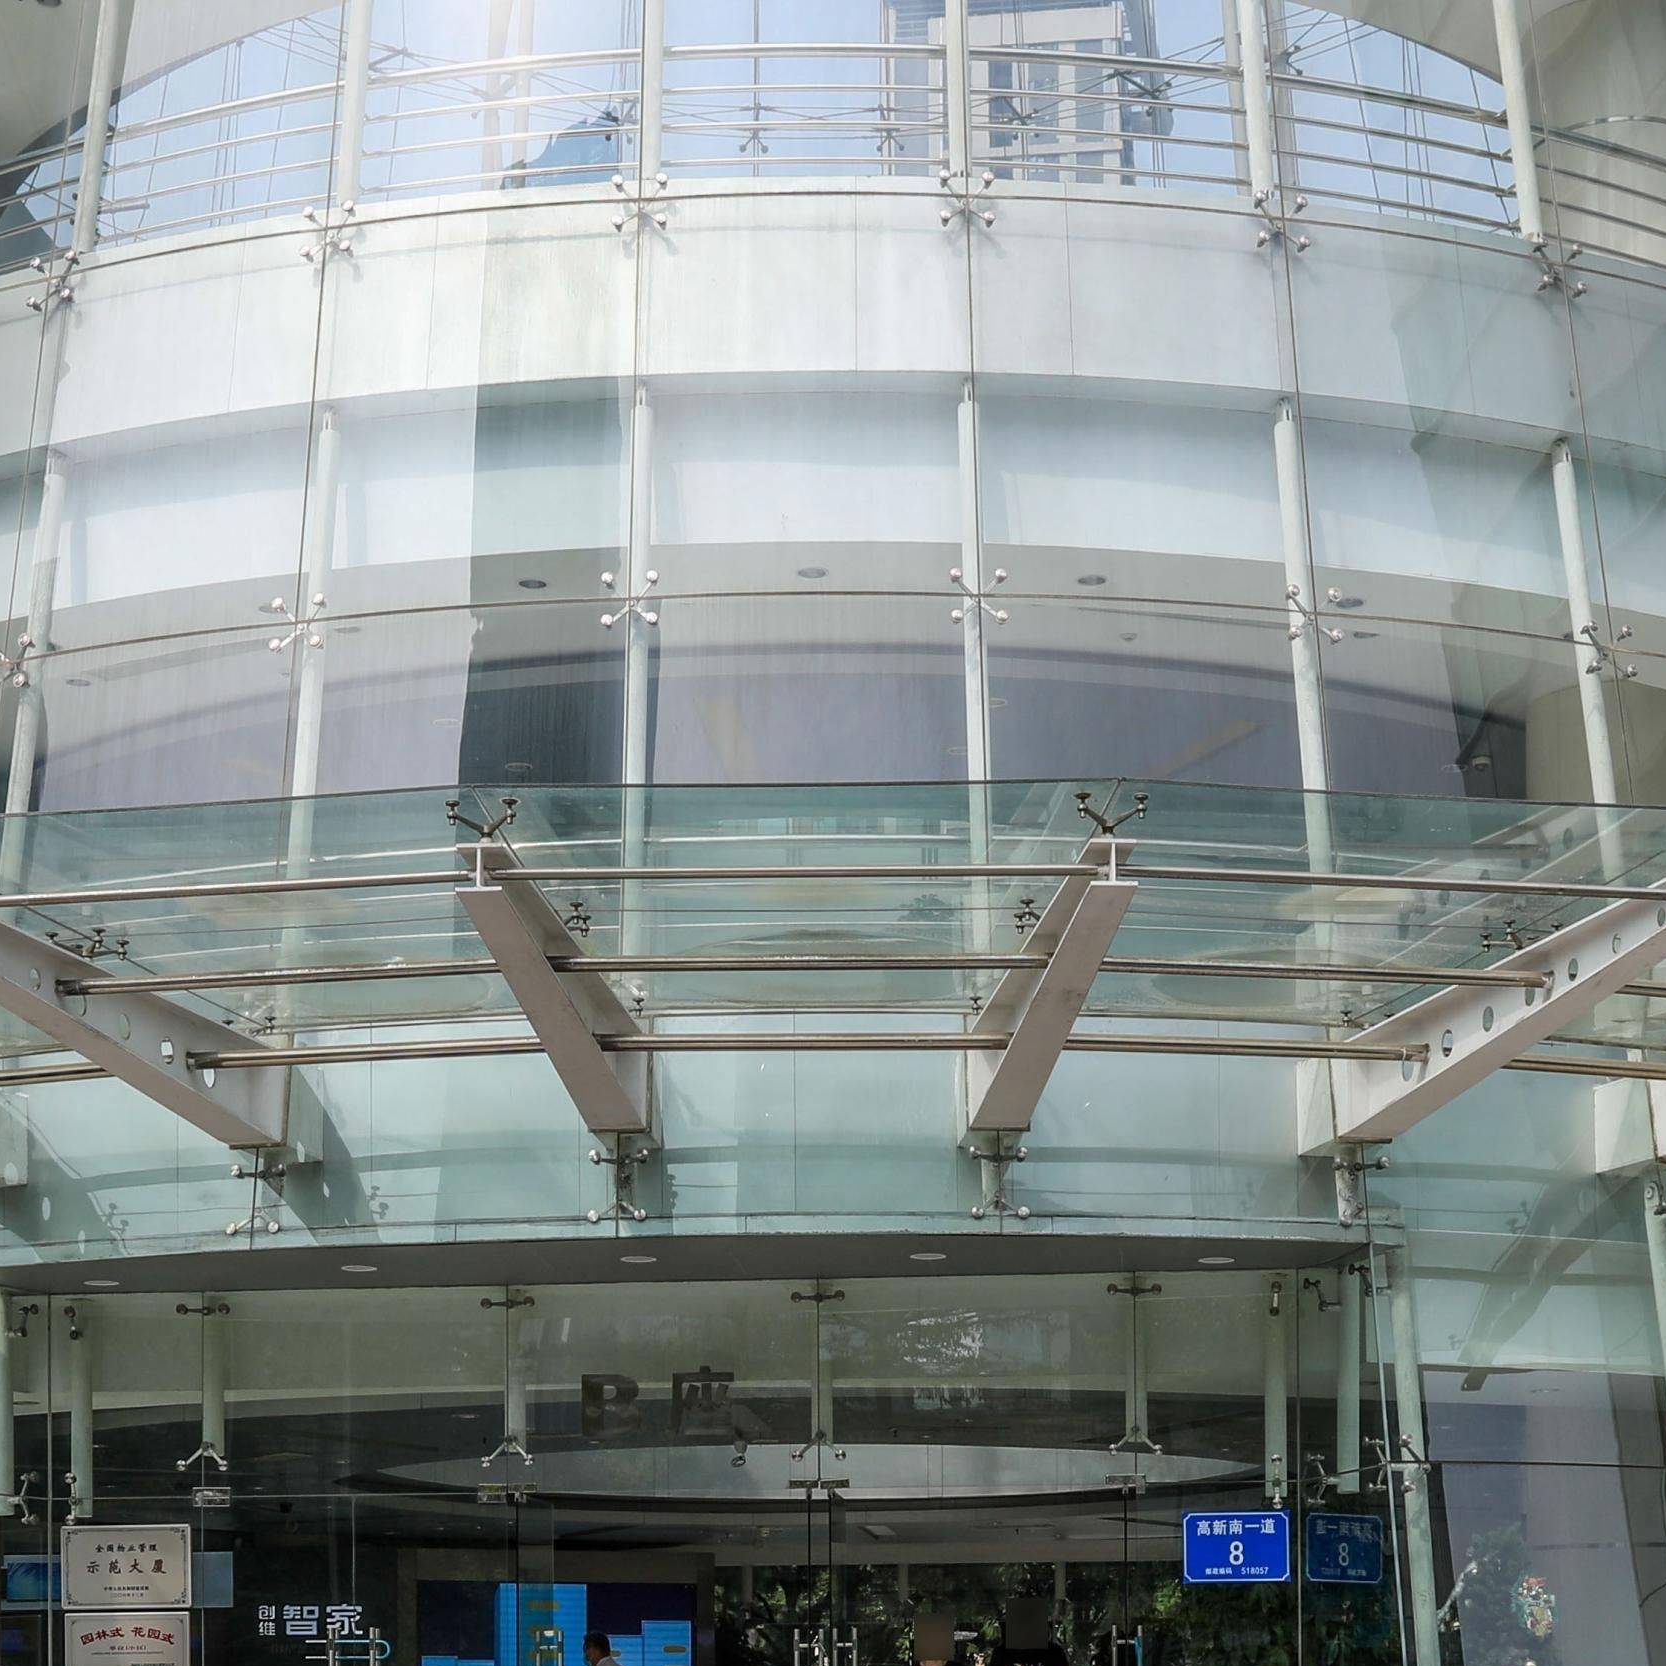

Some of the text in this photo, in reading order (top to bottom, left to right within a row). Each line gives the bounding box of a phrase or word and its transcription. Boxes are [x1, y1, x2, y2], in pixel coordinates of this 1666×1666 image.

[1196, 1518, 1277, 1536] 高新南一道
[95, 1543, 158, 1553] 全国物业管理
[1229, 1541, 1244, 1566] 8
[86, 1558, 167, 1574] 示范大厦
[1241, 1566, 1269, 1575] 518057
[258, 1603, 364, 1637] 创维 智家
[80, 1626, 175, 1646] 园林式 花园式
